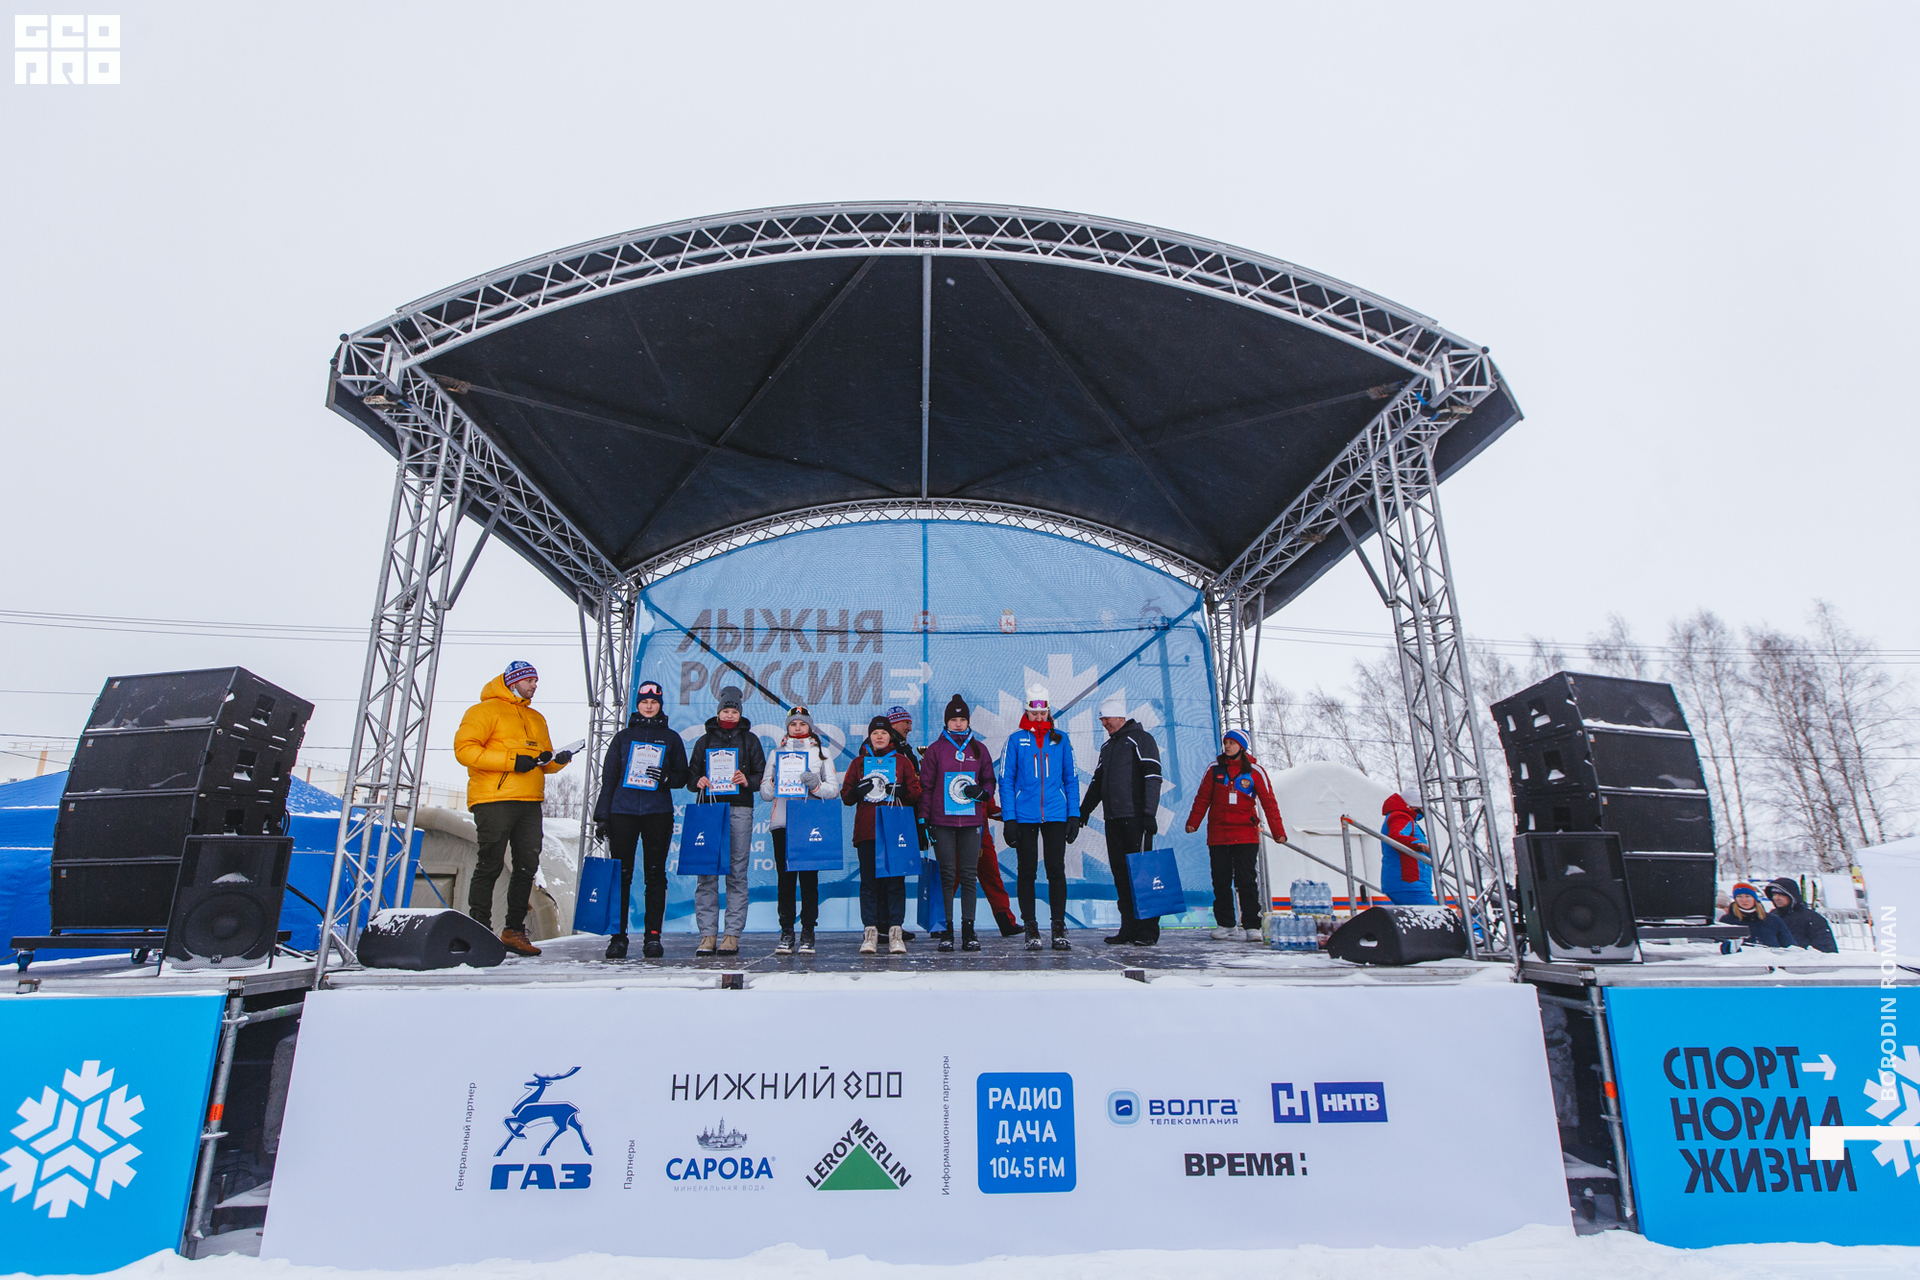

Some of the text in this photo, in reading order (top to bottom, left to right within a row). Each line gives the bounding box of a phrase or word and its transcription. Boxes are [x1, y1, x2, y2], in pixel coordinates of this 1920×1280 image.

[675, 608, 884, 654] ЛЫЖНЯ
[678, 660, 884, 706] РОССИИ
[672, 1066, 835, 1101] НИЖНИЙ
[1663, 1046, 1800, 1090] СПОРТ
[988, 1087, 1062, 1111] РАДИО
[1321, 1093, 1380, 1112] ННТВ
[1670, 1096, 1844, 1141] НОРМА
[455, 1082, 478, 1191] Генеральный партнер
[942, 1055, 952, 1196] Информационные партнеры
[996, 1119, 1057, 1145] ДАЧА
[1149, 1117, 1239, 1126] ТЕЛЕКОМПАНИЯ
[623, 1139, 637, 1190] Партнеры
[805, 1117, 912, 1189] LEROY MERLIN
[1038, 1156, 1065, 1178] FM
[1679, 1147, 1857, 1193] ЖИЗНИ
[490, 1163, 592, 1190] ГАЗ
[673, 1184, 766, 1192] МИНЕРАЛЬНАЯ ВОДА
